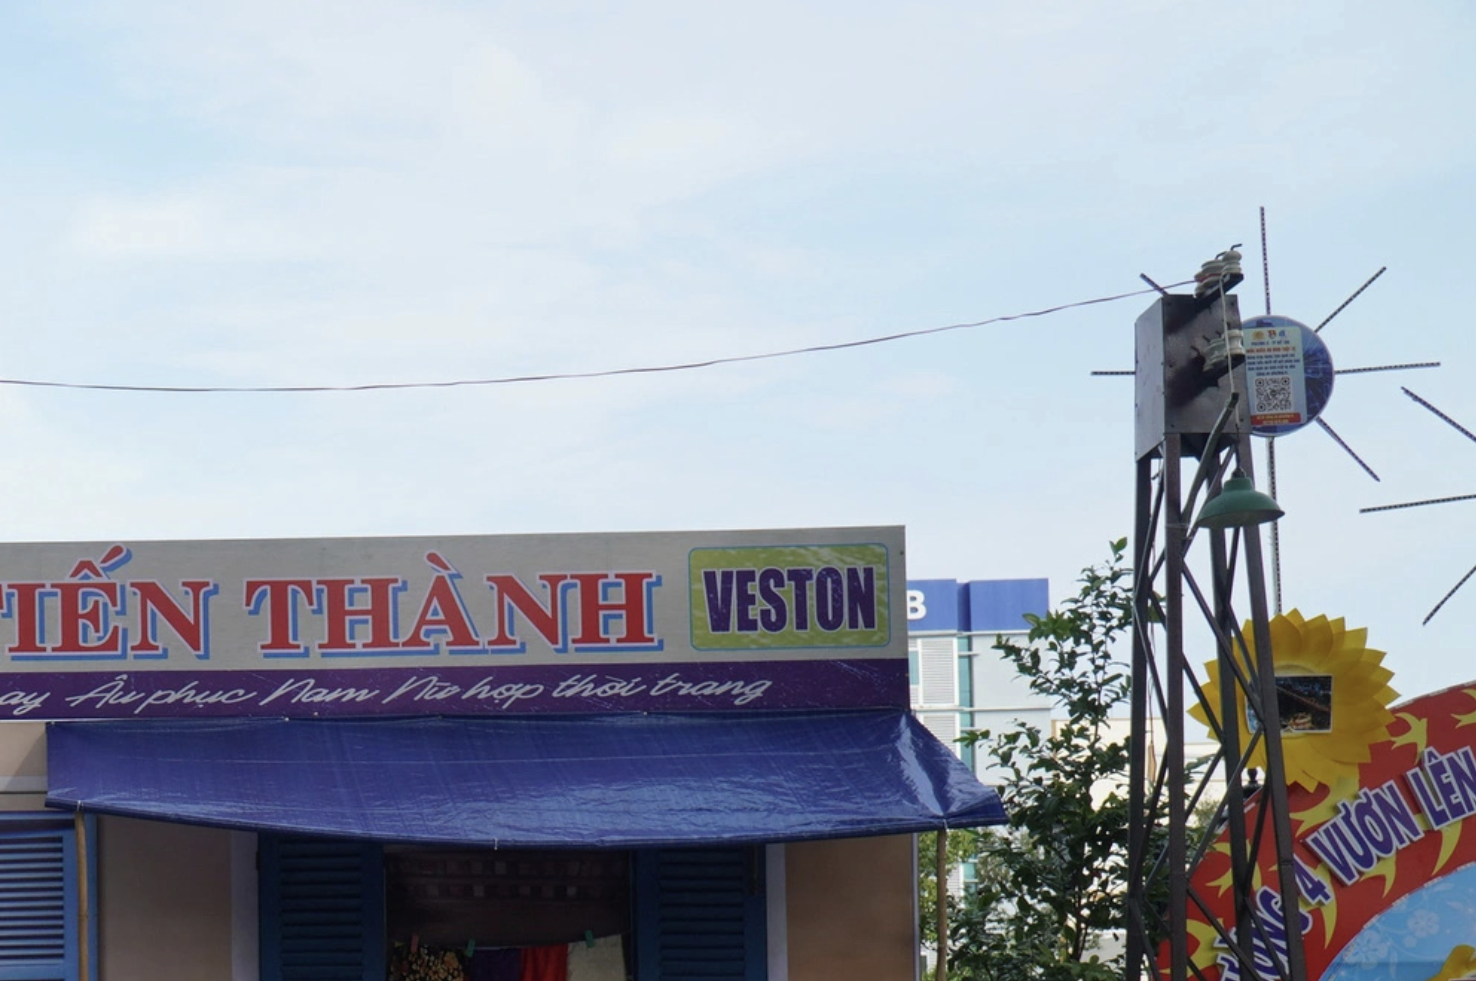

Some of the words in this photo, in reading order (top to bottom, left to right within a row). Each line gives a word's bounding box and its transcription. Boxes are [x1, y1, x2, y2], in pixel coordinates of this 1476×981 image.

[244, 550, 664, 658] THÀNH
[702, 565, 877, 634] VESTON
[134, 680, 257, 713] phục
[259, 678, 378, 705] Nam
[649, 675, 772, 705] trang
[1305, 779, 1425, 887] VƯƠN
[1406, 744, 1476, 832] LÊN
